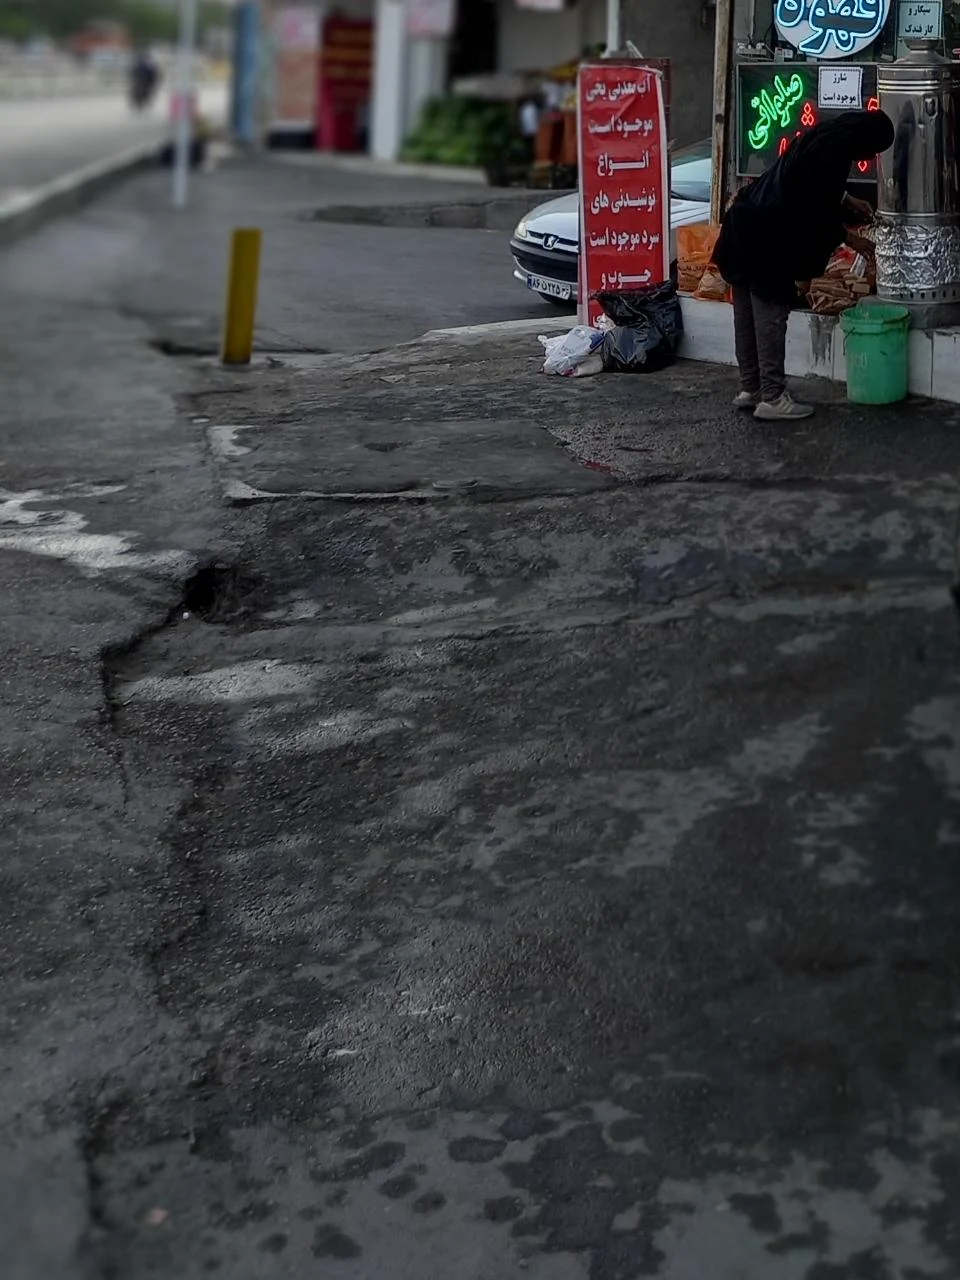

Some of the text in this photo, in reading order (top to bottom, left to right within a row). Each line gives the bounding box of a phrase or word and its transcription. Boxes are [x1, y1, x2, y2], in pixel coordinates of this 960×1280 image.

[608, 77, 636, 101] معدنی
[636, 73, 651, 98] آب
[823, 92, 856, 102] موجود است
[748, 74, 803, 150] صلواتی
[588, 114, 653, 138] موجود است
[597, 150, 650, 176] انواع
[590, 227, 660, 252] سرد موجود است
